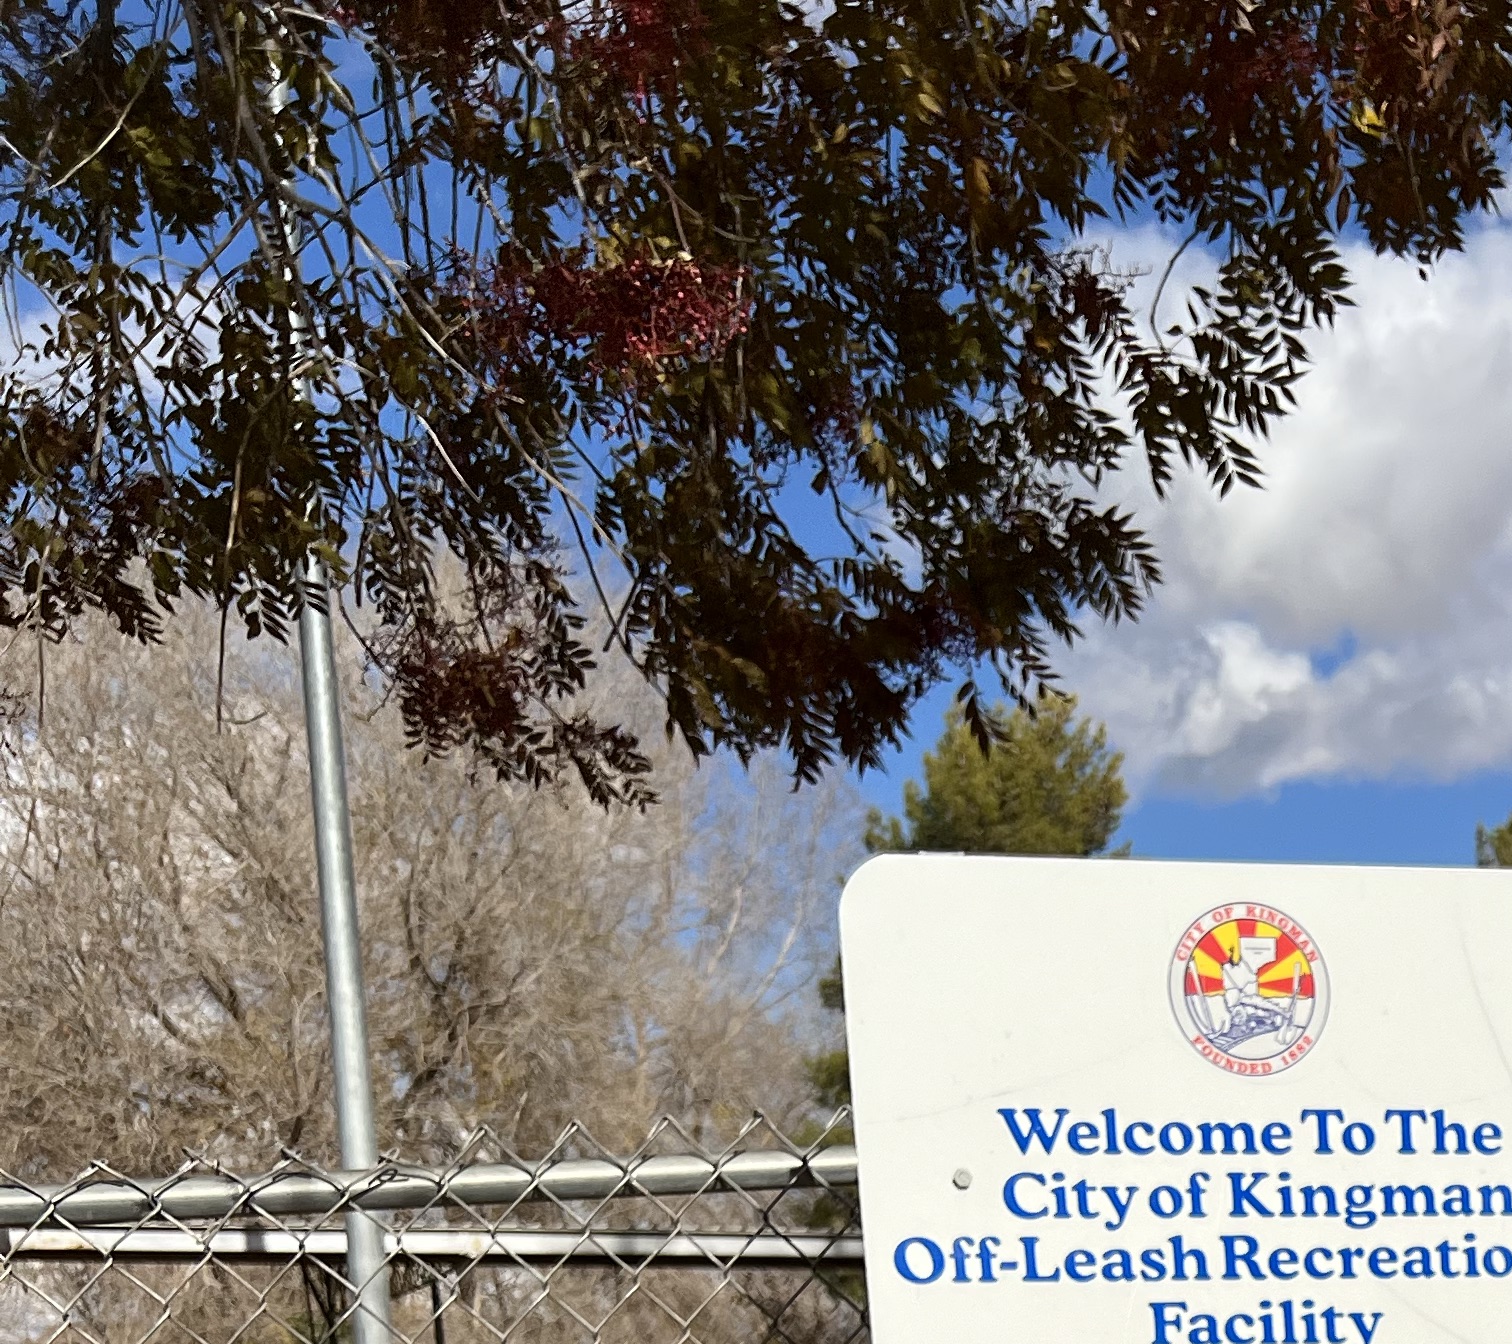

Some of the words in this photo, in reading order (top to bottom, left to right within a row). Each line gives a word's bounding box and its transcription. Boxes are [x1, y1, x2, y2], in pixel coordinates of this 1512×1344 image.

[1175, 921, 1207, 962] CITY
[1211, 906, 1235, 924] OF
[1245, 904, 1320, 964] KINGMAN
[1191, 1034, 1273, 1075] FOUNDED
[1281, 1034, 1314, 1067] 1882
[997, 1107, 1292, 1156] Welcome
[1300, 1108, 1376, 1155] To
[1384, 1108, 1503, 1155] The
[1002, 1171, 1138, 1231] City
[1148, 1171, 1211, 1219] of
[892, 1234, 1211, 1284] Off-Leash
